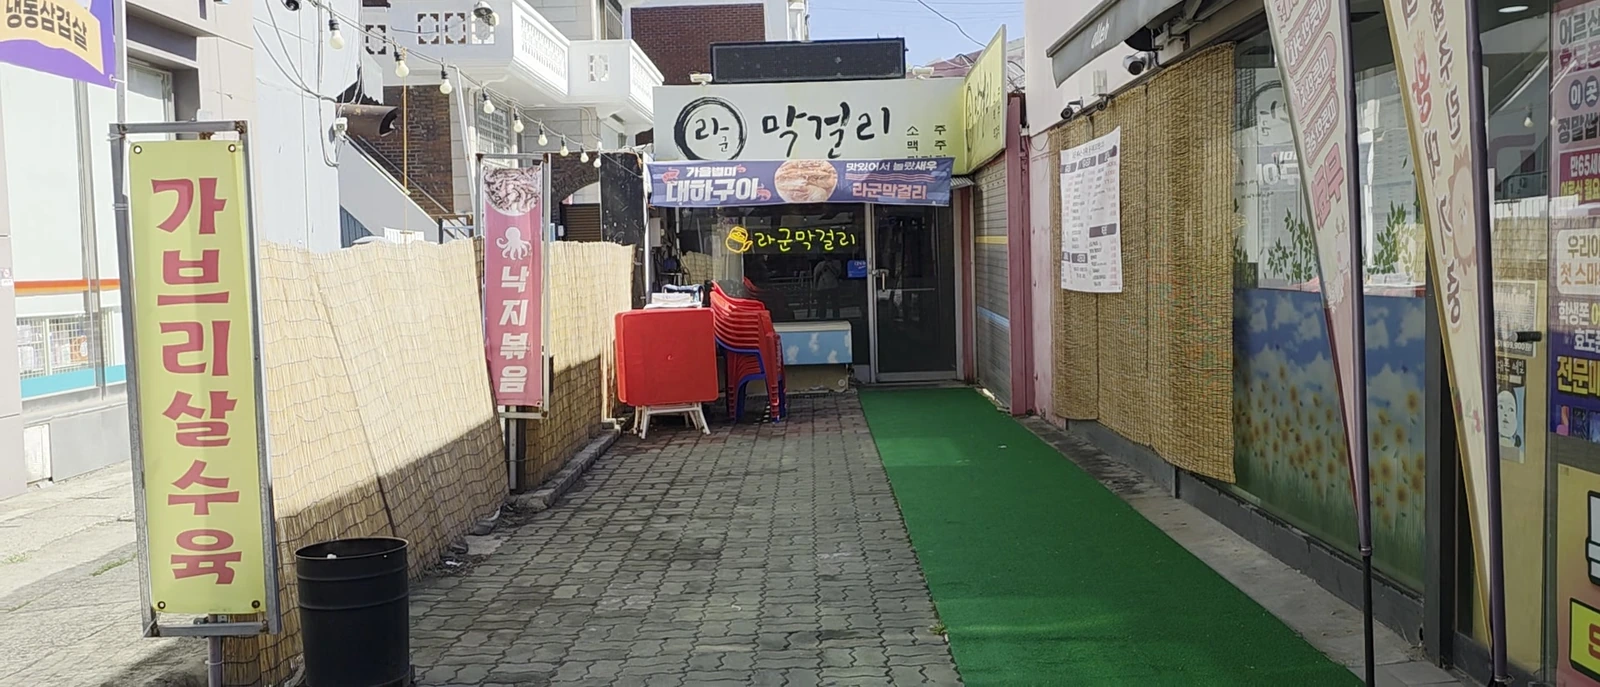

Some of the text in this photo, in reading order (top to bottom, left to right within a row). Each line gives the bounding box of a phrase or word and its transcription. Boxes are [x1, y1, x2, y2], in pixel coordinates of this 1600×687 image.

[6, 0, 88, 51] 냉동삼겹살
[762, 101, 892, 158] 막걸리
[686, 166, 737, 178] 가을별미
[846, 162, 891, 172] 맛있어서
[666, 178, 760, 203] 대하구이
[852, 182, 928, 200] 라군막걸리
[754, 227, 857, 252] 라군막걸리
[499, 265, 530, 393] 낙지볶음
[150, 176, 243, 586] 가브리살수육
